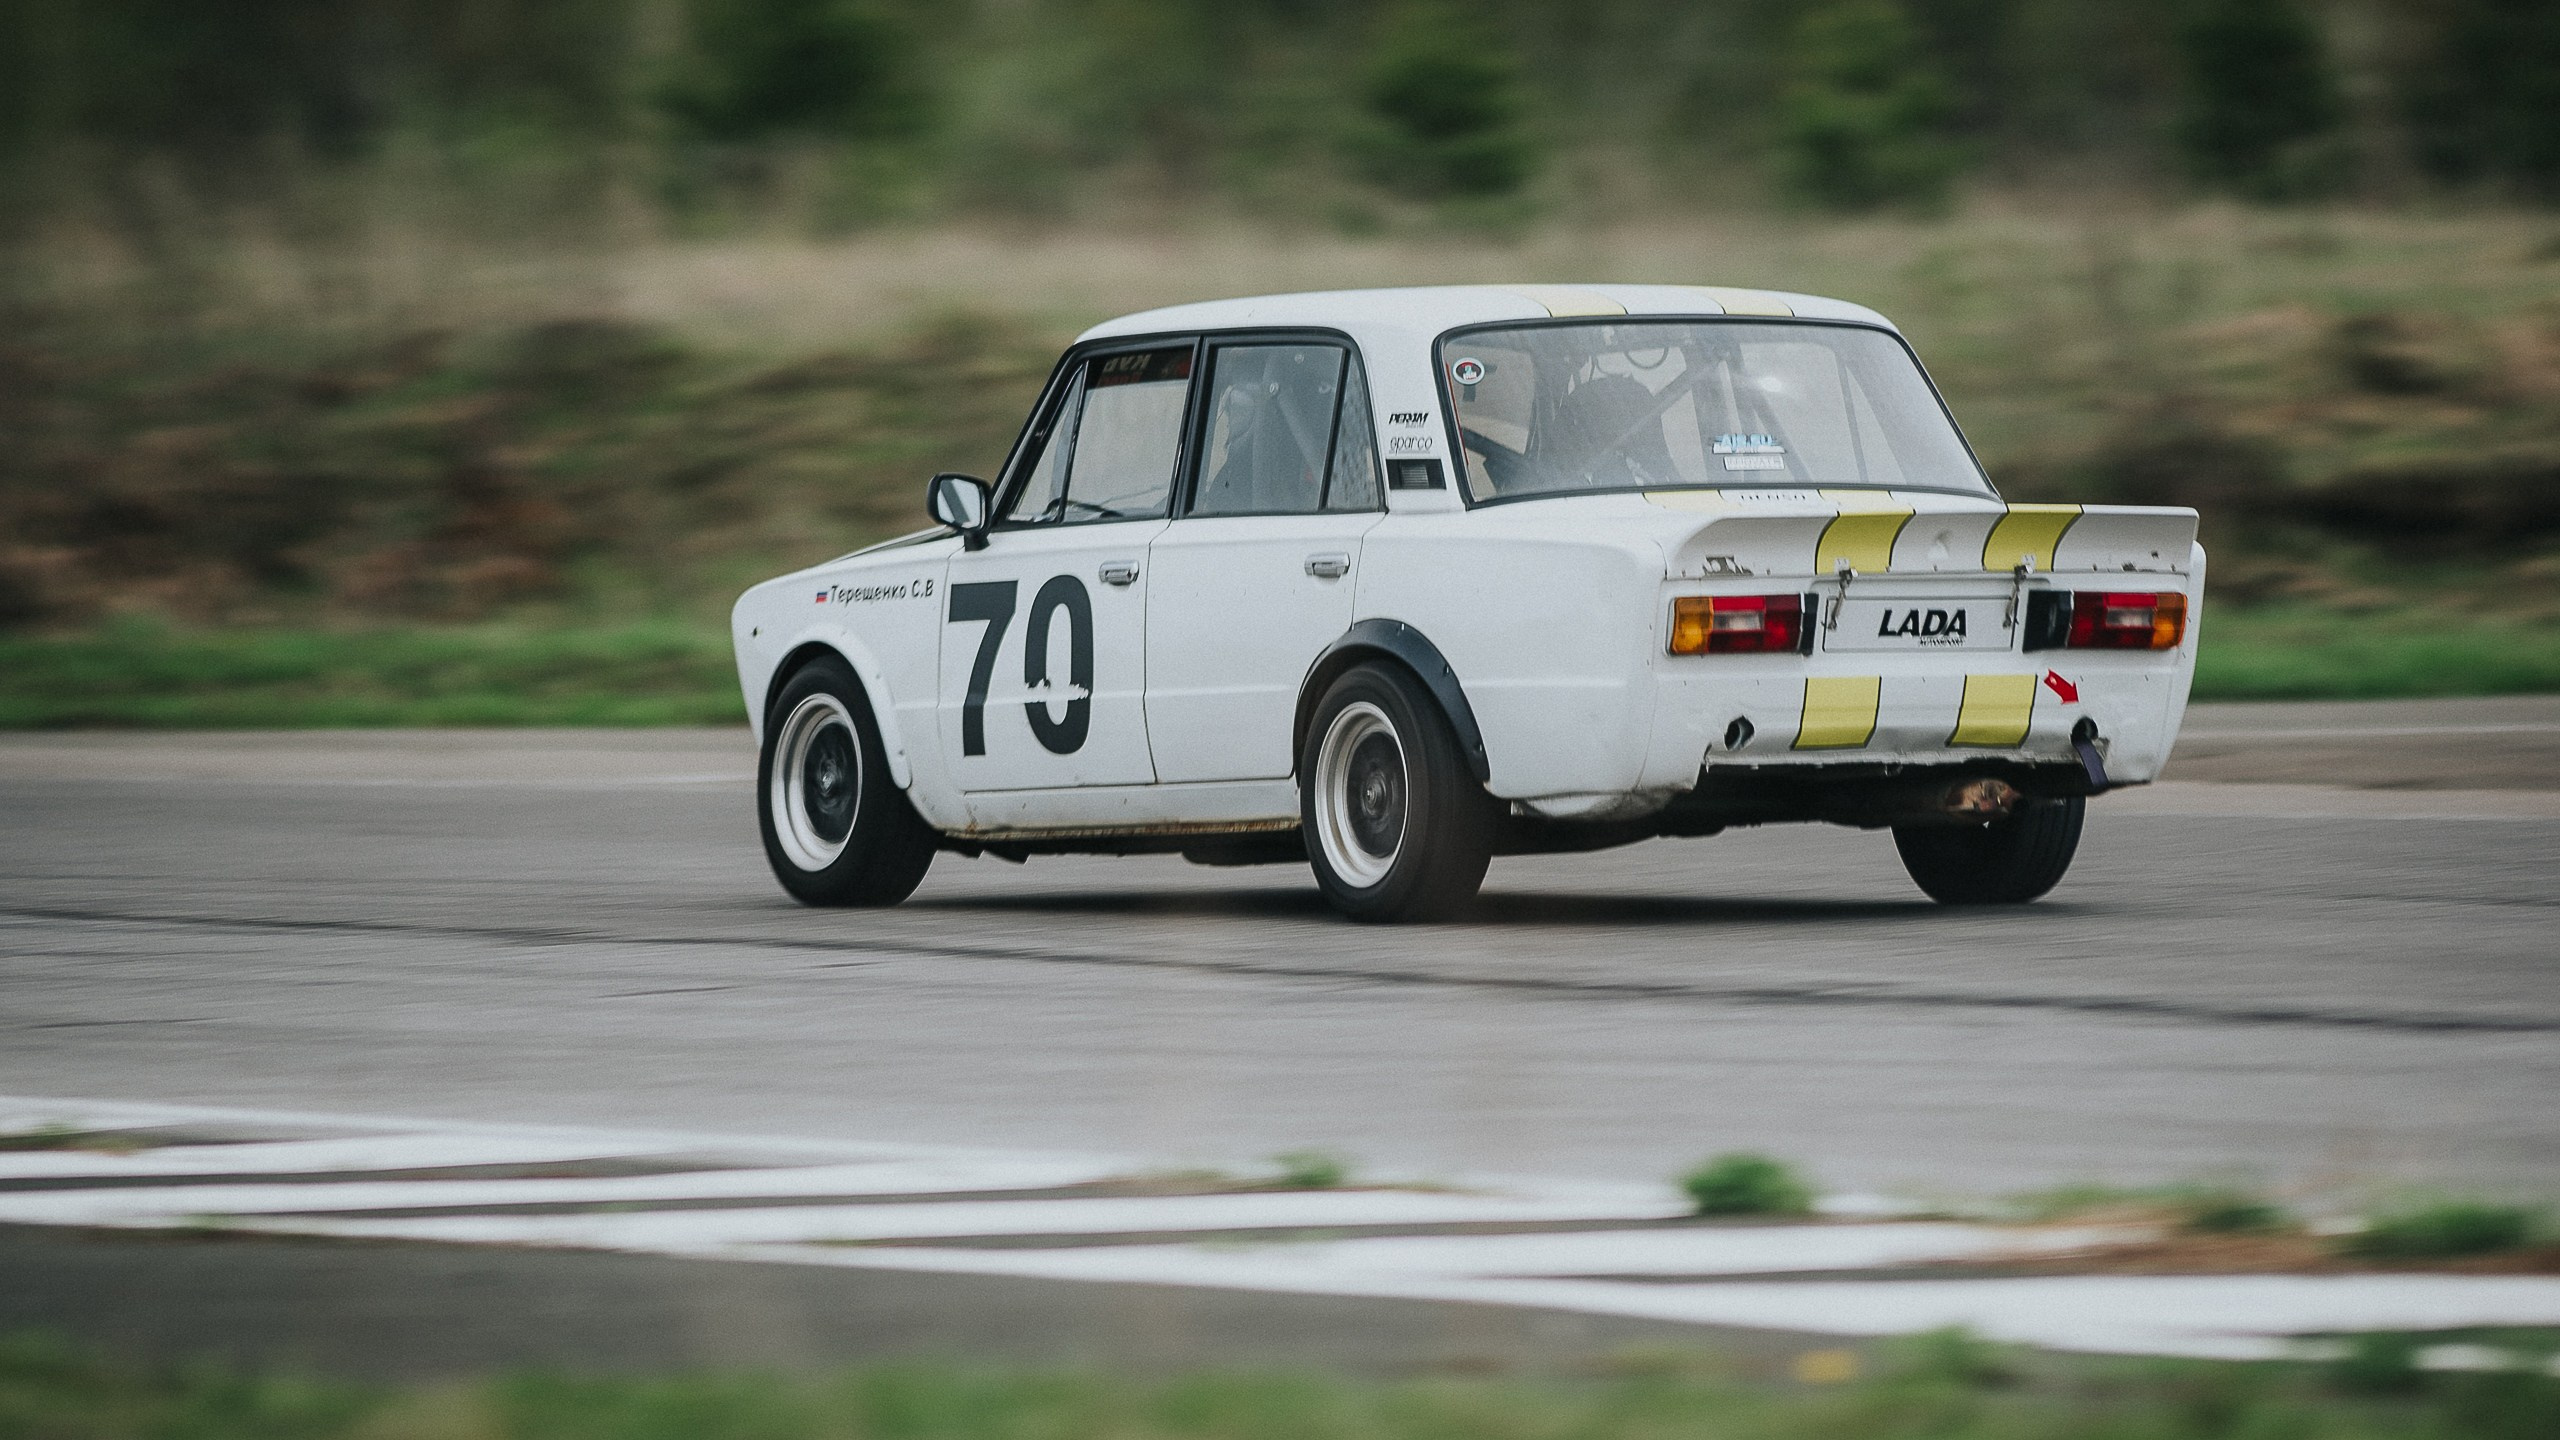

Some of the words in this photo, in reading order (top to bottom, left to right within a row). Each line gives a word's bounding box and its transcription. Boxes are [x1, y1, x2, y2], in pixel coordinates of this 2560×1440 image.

[1390, 436, 1433, 455] sparco
[831, 584, 906, 608] Терещенко
[1878, 608, 1967, 637] LADA
[949, 574, 1094, 757] 70
